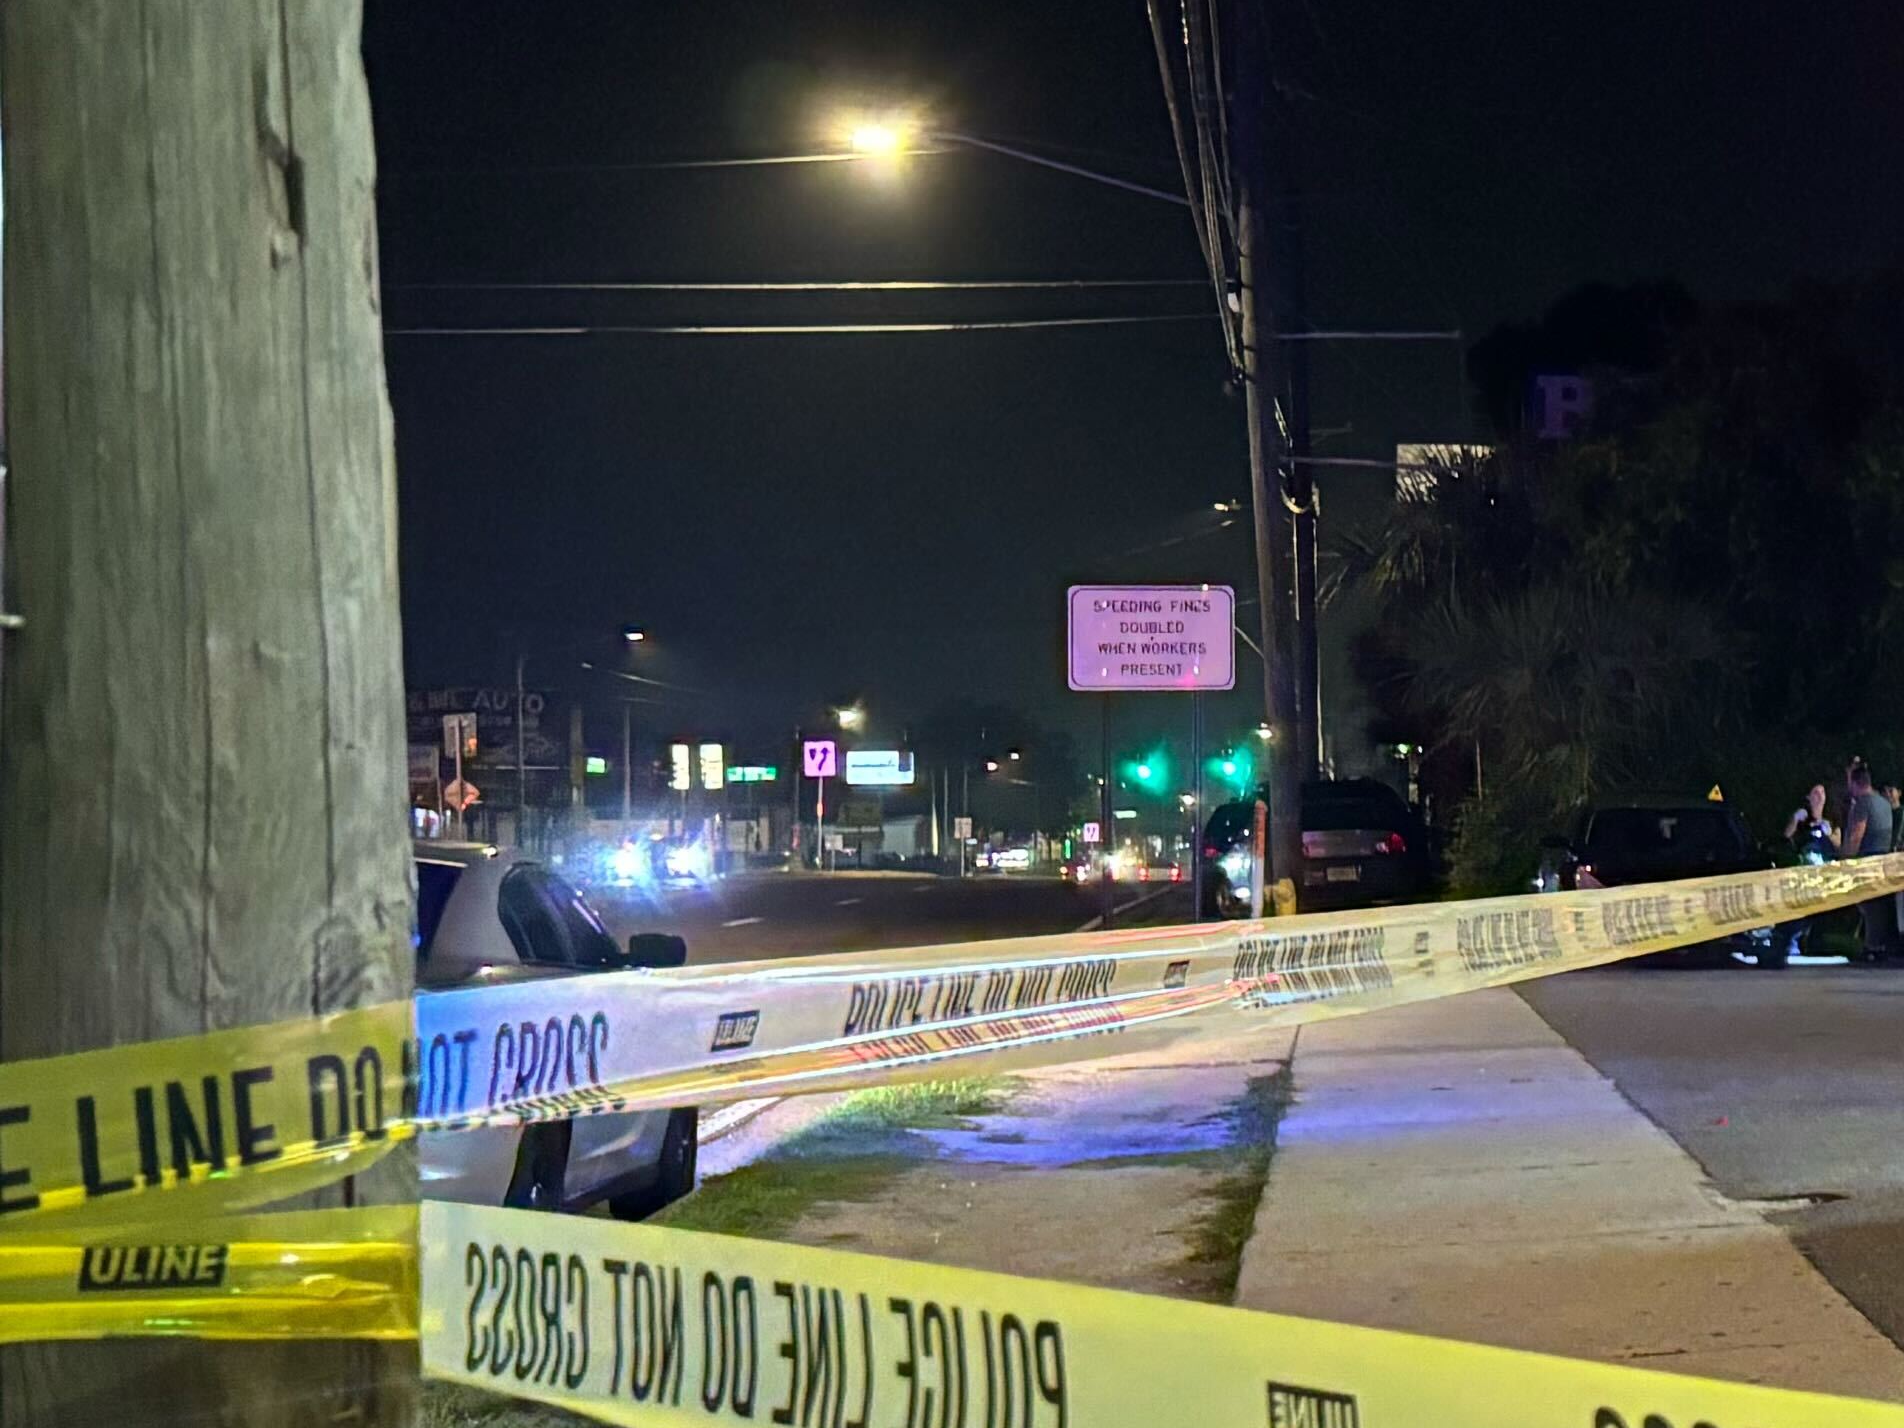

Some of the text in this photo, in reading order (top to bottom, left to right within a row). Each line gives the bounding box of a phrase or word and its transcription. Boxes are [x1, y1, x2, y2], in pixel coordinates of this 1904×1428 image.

[1093, 599, 1211, 613] SPEEDING FINES
[1120, 621, 1185, 634] DOUBLED
[1098, 642, 1207, 655] WHEN WORKERS
[1120, 663, 1183, 676] PRESENT
[76, 1065, 283, 1197] LINE
[307, 1045, 386, 1149] DO
[86, 1245, 222, 1286] ULINE
